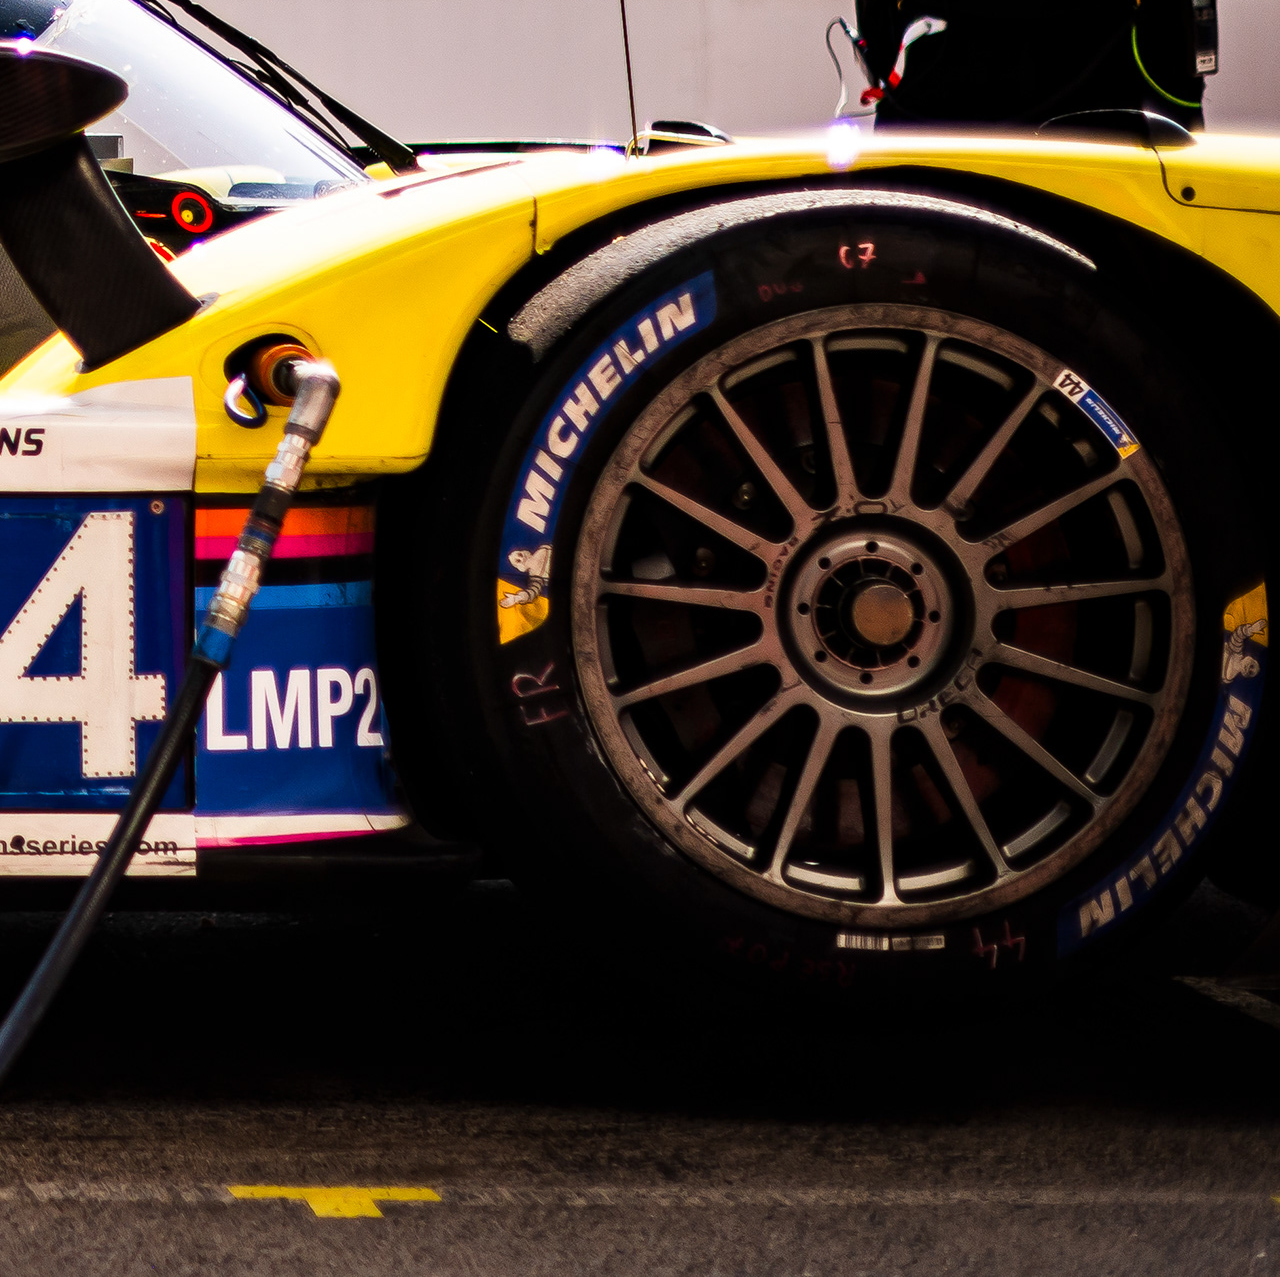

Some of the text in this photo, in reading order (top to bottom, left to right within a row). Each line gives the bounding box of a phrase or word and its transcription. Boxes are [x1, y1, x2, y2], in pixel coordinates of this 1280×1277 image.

[516, 292, 696, 534] MICHELIN
[205, 667, 385, 751] LMP2
[1079, 694, 1253, 939] MICHELIN
